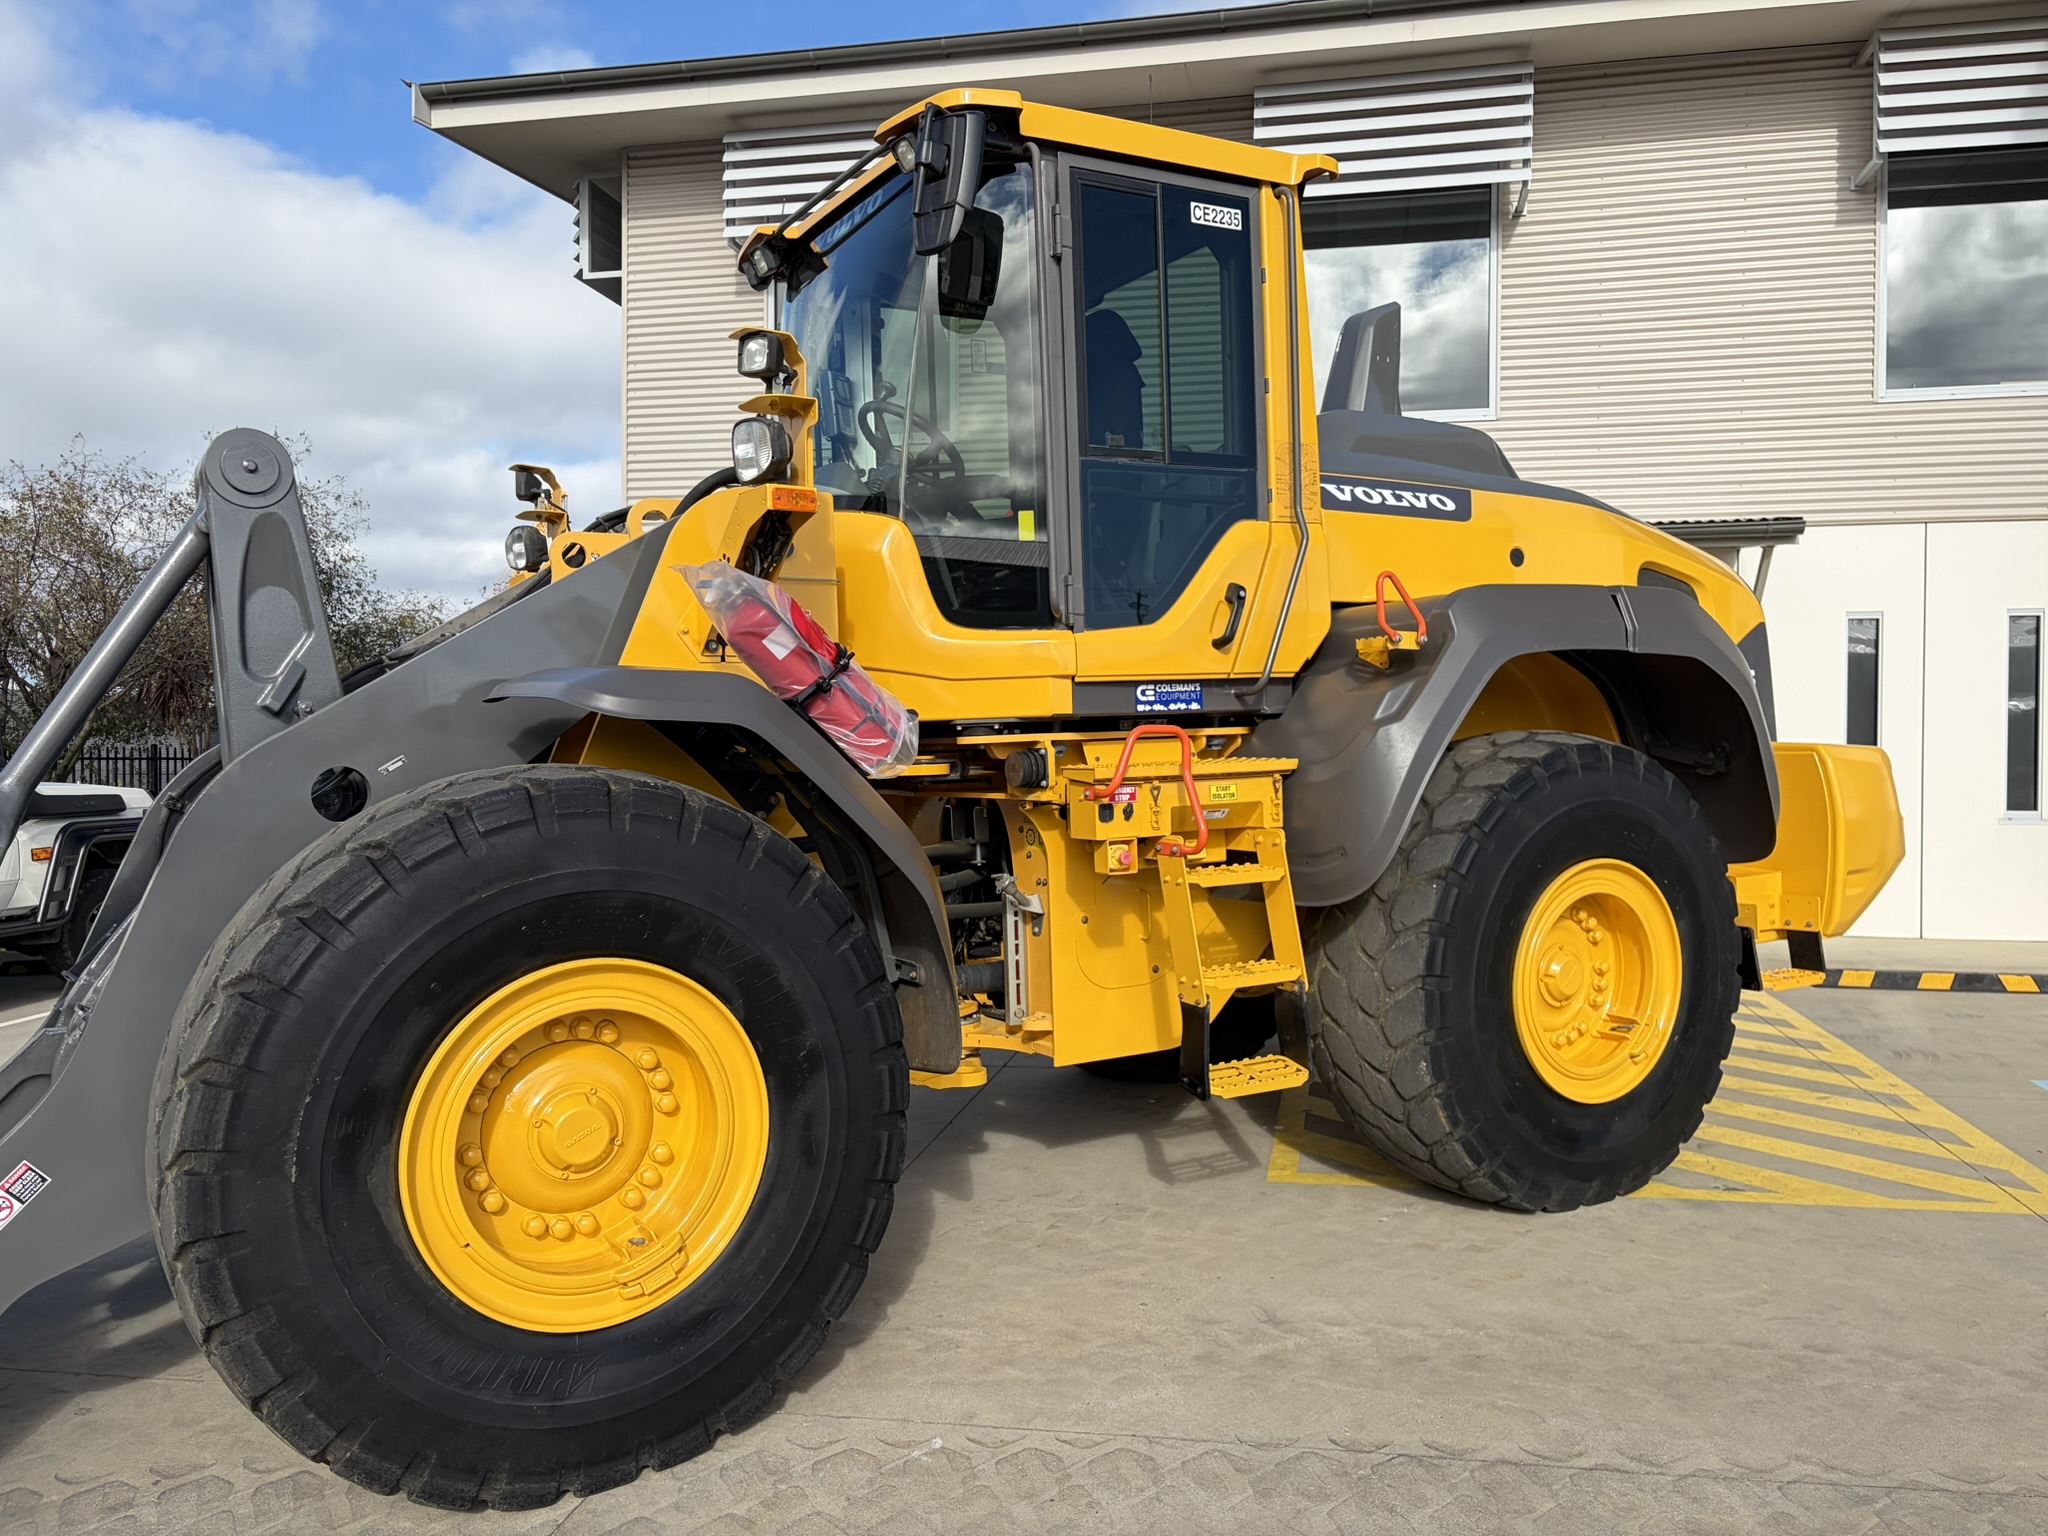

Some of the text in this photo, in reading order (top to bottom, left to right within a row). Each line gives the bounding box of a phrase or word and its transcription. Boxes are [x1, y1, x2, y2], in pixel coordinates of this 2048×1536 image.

[1193, 204, 1240, 228] CE2235
[1320, 483, 1457, 511] VOLVO
[1156, 683, 1201, 693] COLEMAN'S
[1156, 692, 1201, 701] EQUIPMENT
[1215, 785, 1231, 793] START
[1114, 793, 1131, 802] STOP
[1212, 792, 1235, 800] ISOLATOR
